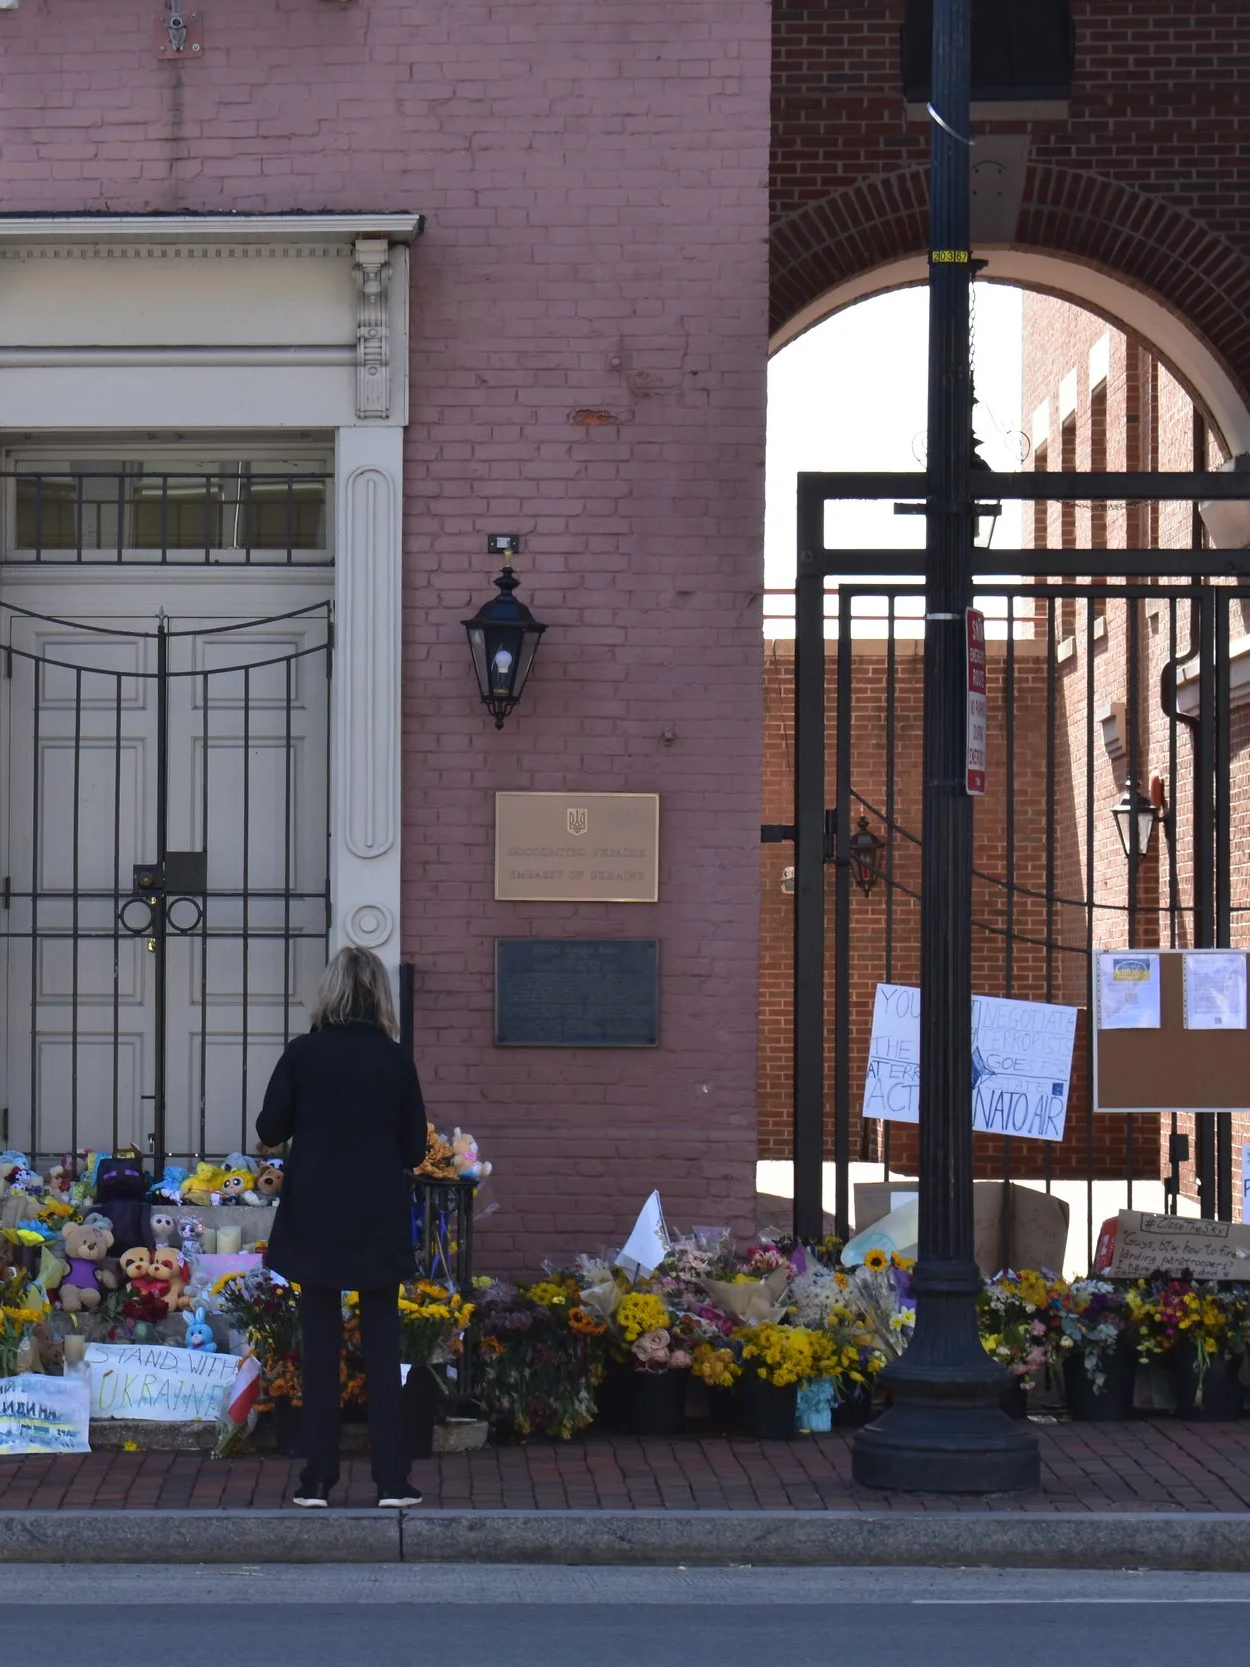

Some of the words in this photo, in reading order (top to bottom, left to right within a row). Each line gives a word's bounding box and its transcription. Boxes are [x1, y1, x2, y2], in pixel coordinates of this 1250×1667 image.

[509, 870, 565, 880] EMBASSY
[568, 870, 584, 880] OF
[590, 870, 646, 882] UKRAINE
[880, 987, 920, 1018] YOU
[982, 1001, 1075, 1032] NEGOTIATE
[870, 1035, 914, 1060] THE
[986, 1053, 1034, 1072] GOES
[981, 1027, 1072, 1056] TERRORISTS
[972, 1085, 1030, 1132] NATO
[1027, 1093, 1064, 1136] AIR
[1119, 1247, 1157, 1265] landing
[1182, 1239, 1203, 1255] how
[1204, 1243, 1217, 1256] to
[1115, 1260, 1124, 1269] I
[1128, 1262, 1150, 1272] have
[91, 1347, 178, 1370] STAND
[188, 1353, 238, 1379] WITH
[99, 1369, 225, 1417] UKRAINE
